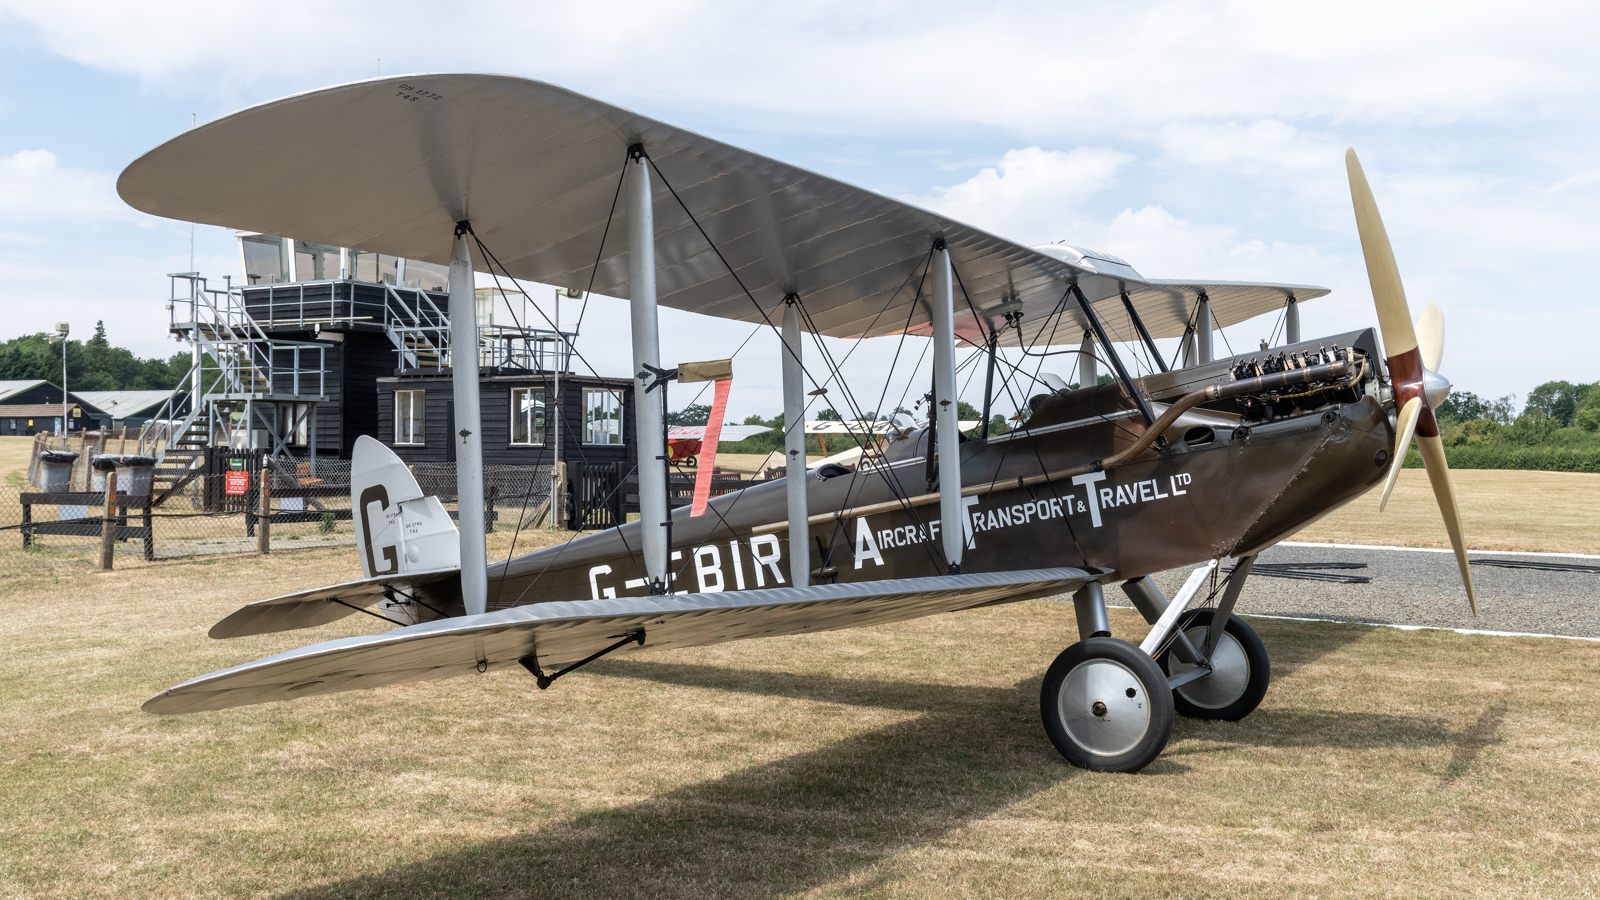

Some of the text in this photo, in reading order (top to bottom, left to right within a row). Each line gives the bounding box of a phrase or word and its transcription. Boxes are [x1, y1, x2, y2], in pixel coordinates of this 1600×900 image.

[399, 83, 415, 91] DH
[961, 494, 1075, 550] TRANSPORT
[1072, 470, 1169, 528] TRAVEL
[1077, 500, 1087, 513] &
[360, 484, 399, 577] G
[854, 516, 943, 570] AIRCRAF
